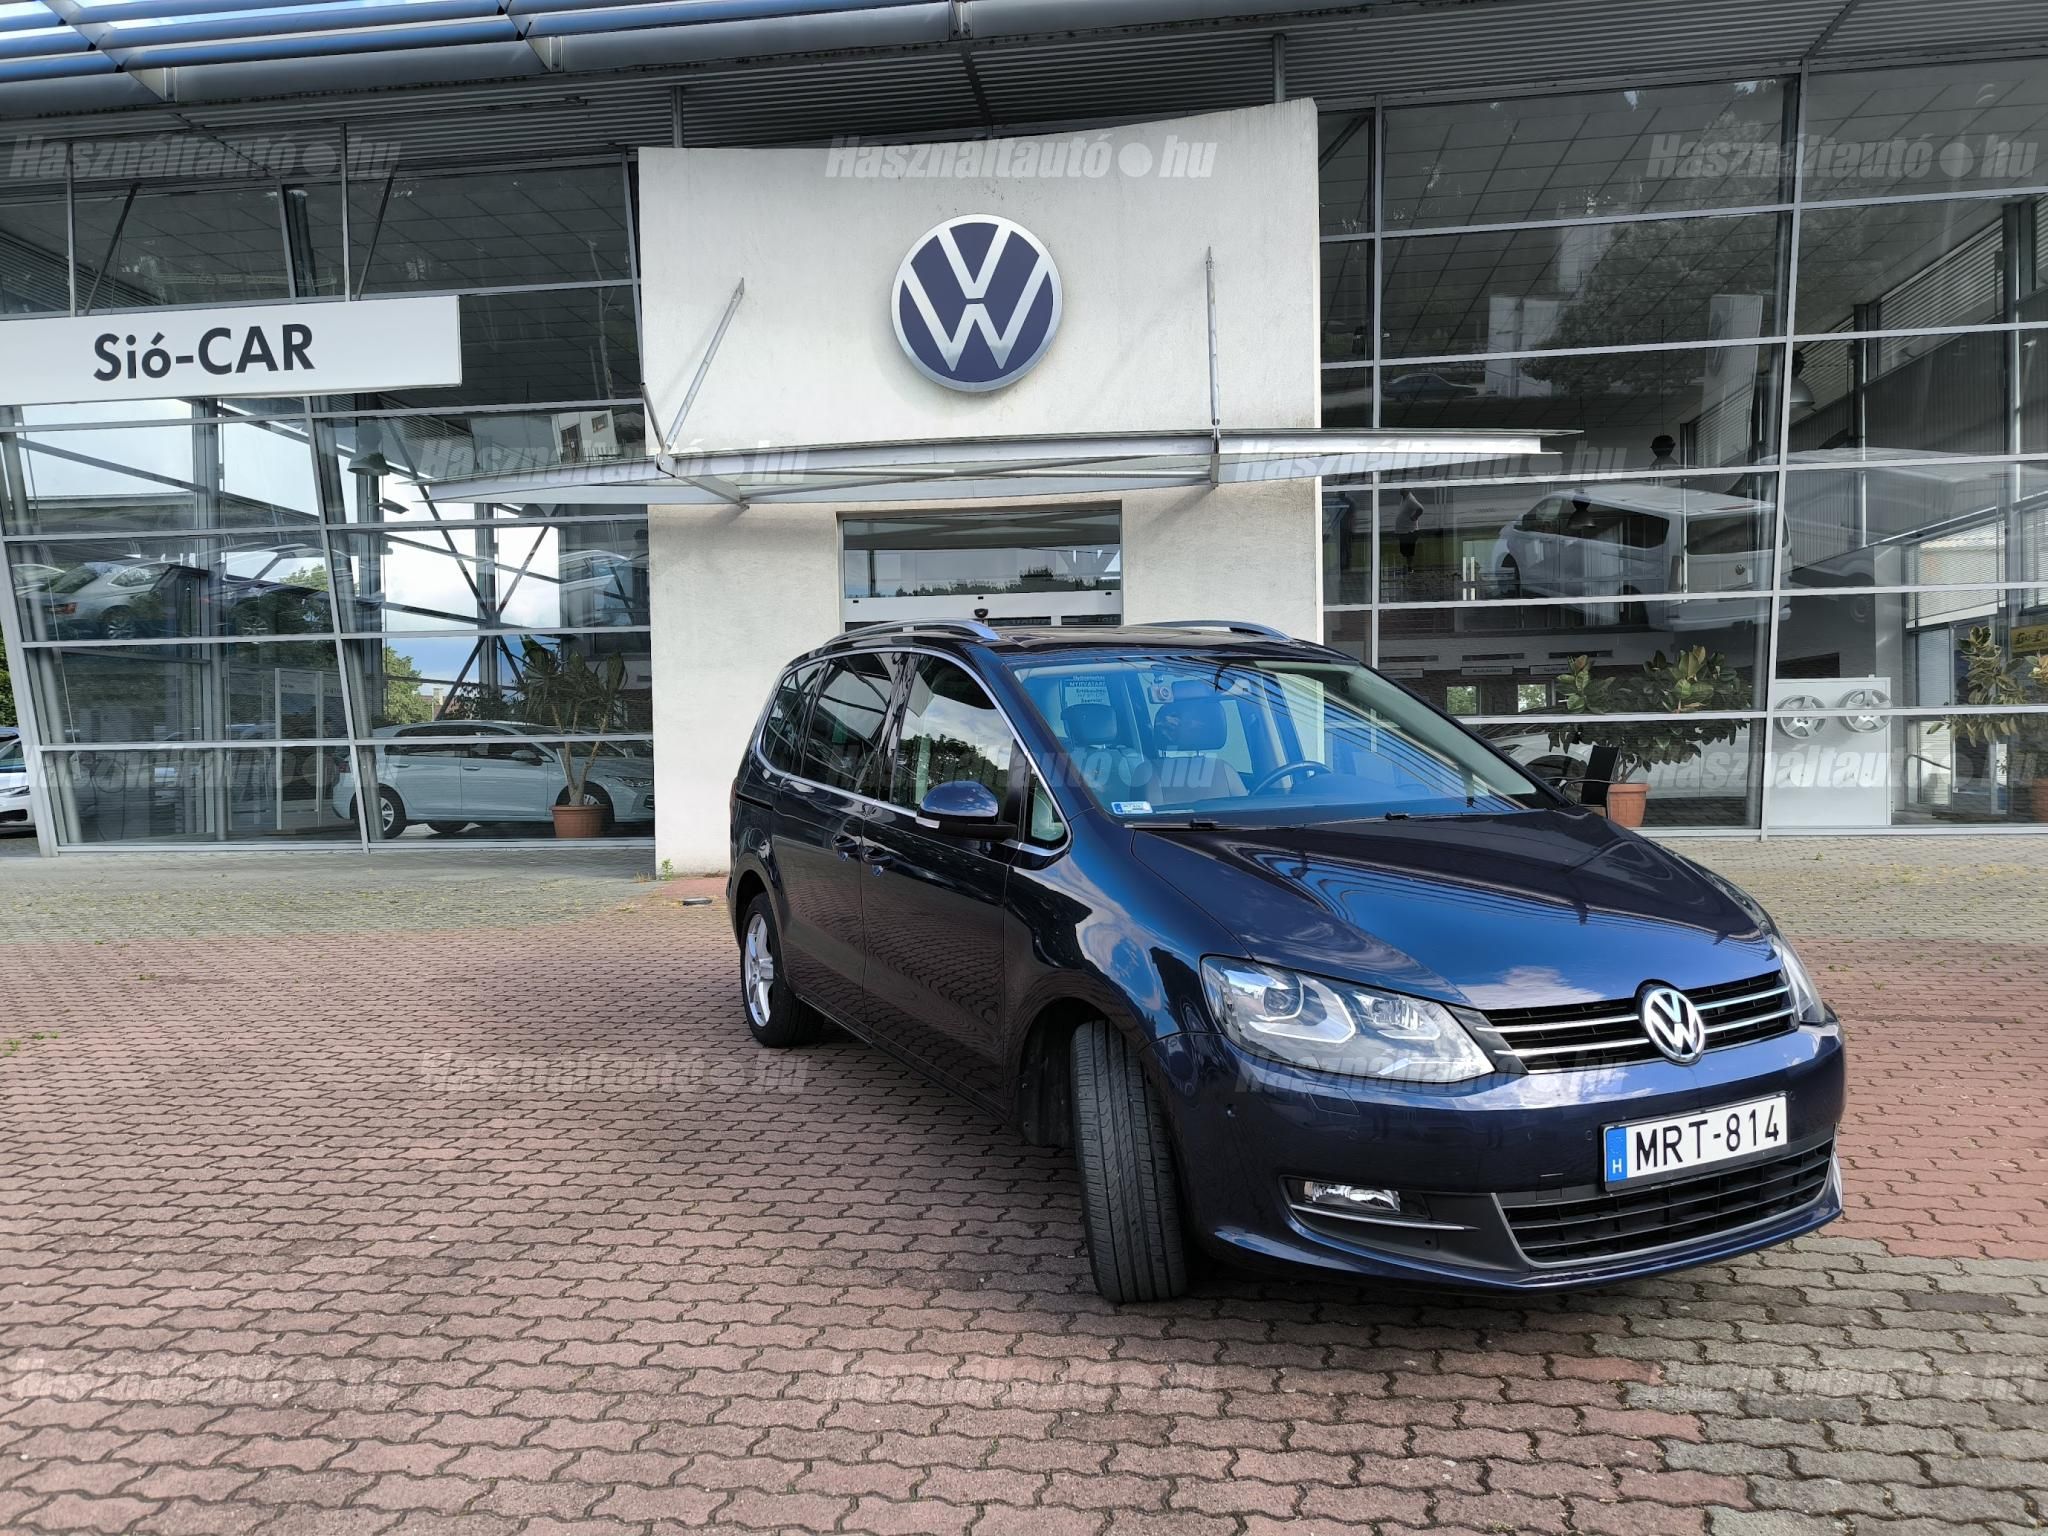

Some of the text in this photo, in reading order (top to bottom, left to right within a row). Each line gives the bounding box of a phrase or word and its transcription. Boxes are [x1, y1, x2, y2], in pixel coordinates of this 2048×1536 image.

[93, 323, 316, 382] Sió-CAR
[1612, 1157, 1622, 1174] H
[1635, 1104, 1779, 1171] MRT-814
